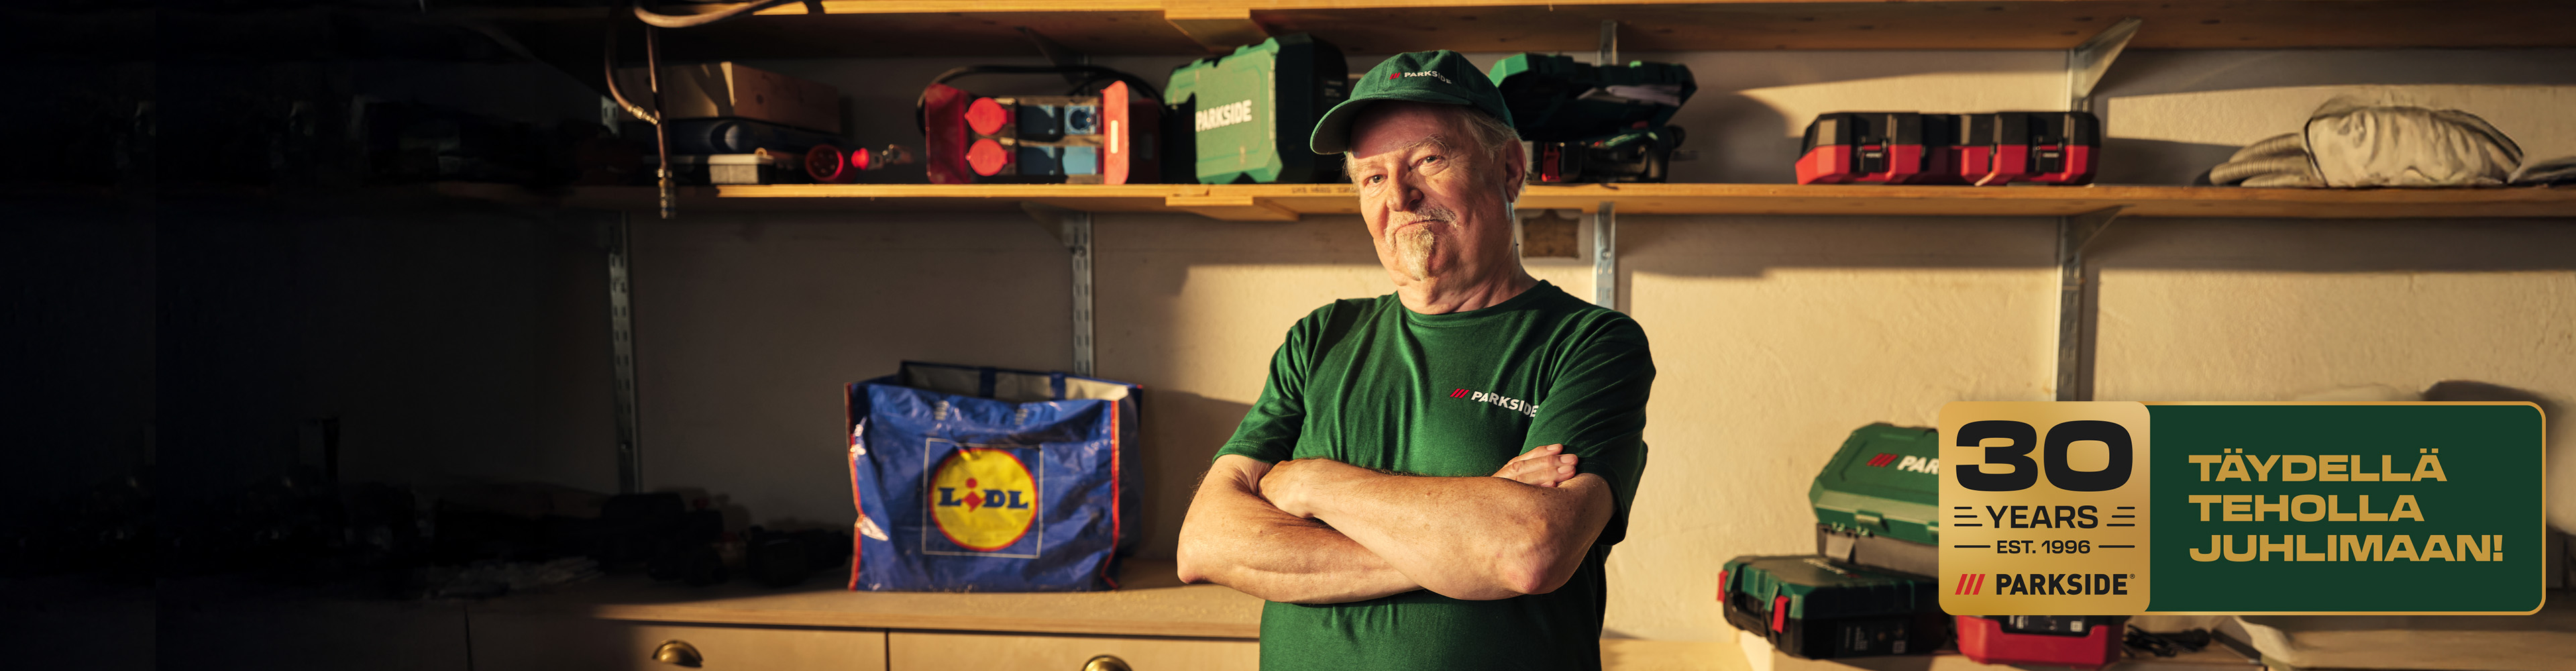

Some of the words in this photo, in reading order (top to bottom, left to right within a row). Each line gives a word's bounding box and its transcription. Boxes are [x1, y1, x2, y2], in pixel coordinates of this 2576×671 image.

[1404, 70, 1452, 84] PARKSIDE
[1195, 99, 1252, 132] PARKSIDE
[1471, 391, 1539, 417] PARKSIDE
